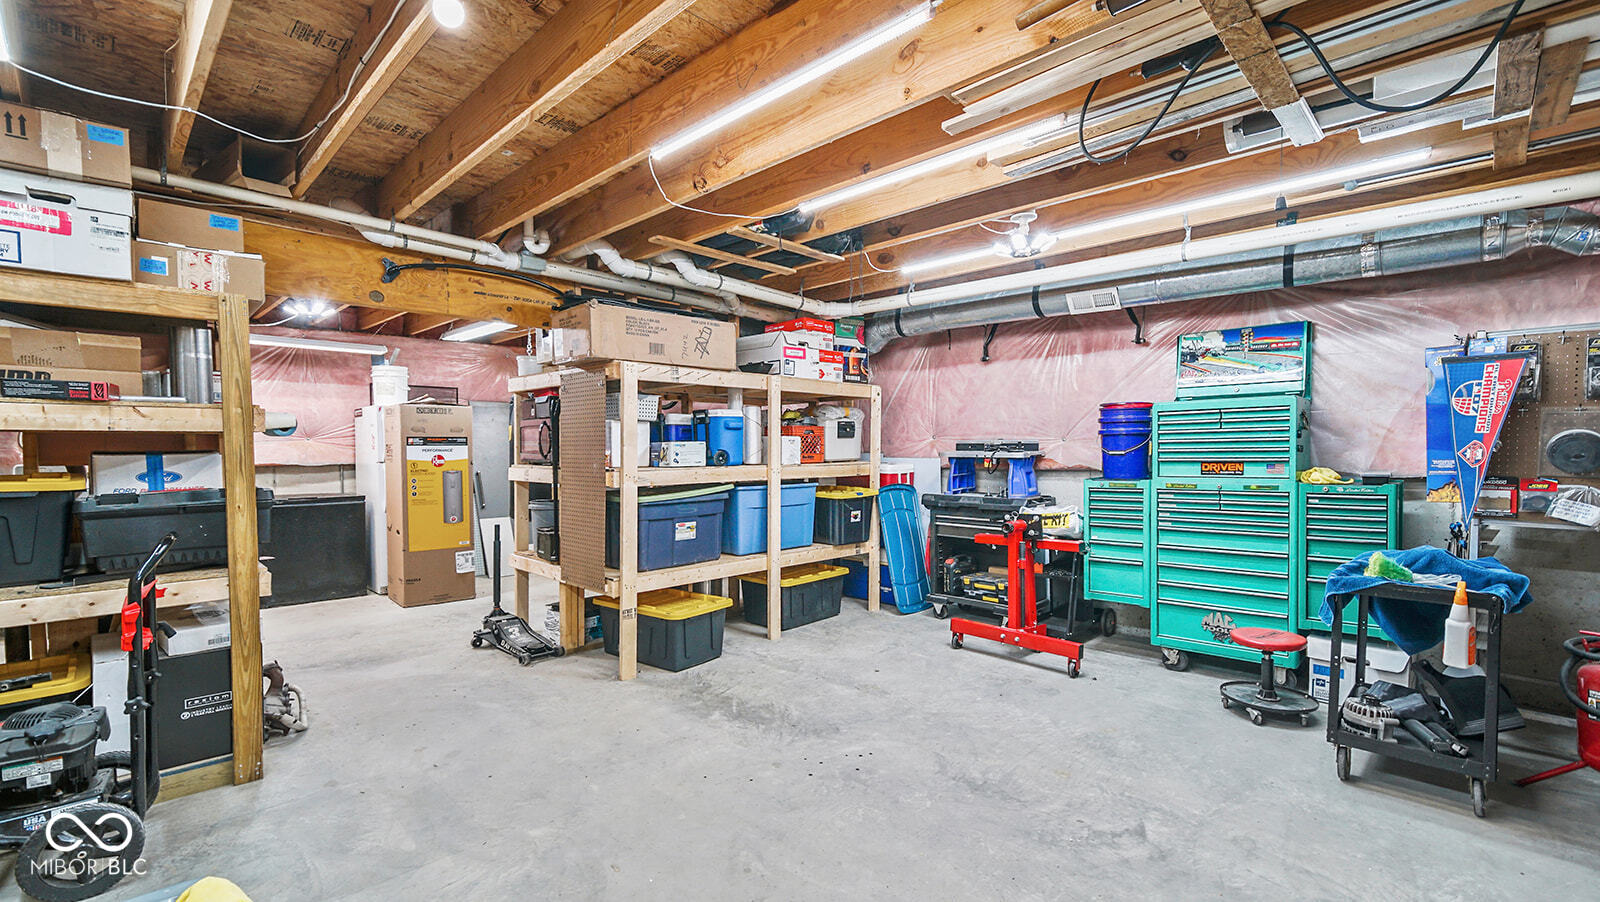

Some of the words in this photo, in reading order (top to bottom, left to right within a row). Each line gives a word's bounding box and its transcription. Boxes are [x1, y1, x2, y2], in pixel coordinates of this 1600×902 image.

[1476, 364, 1495, 432] CHAMPIONS
[1201, 463, 1244, 473] DRIVEN
[1201, 611, 1237, 629] MAC
[23, 815, 47, 827] USA
